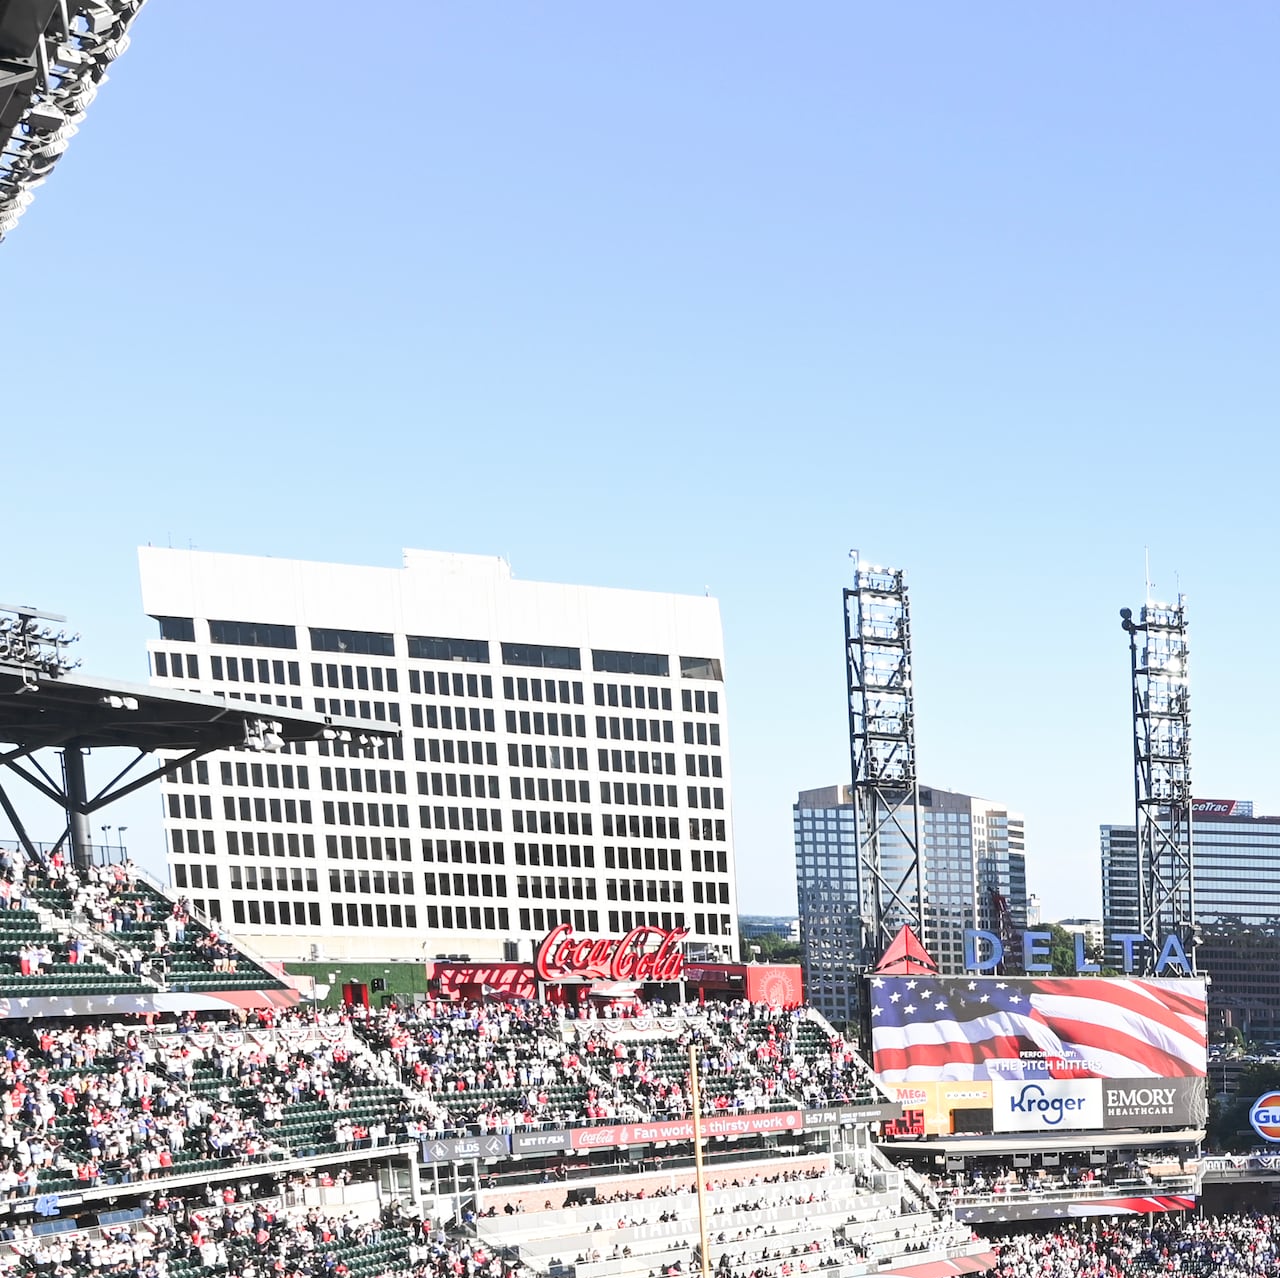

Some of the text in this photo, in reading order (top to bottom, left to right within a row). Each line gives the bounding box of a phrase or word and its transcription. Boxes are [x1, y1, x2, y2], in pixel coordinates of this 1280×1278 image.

[963, 929, 1193, 973] DELTA
[1020, 1060, 1054, 1071] PITCH
[896, 1088, 927, 1100] MEGA
[1106, 1088, 1177, 1107] EMORY
[1010, 1084, 1085, 1125] Kroger
[1107, 1107, 1174, 1116] HEALTHCARE
[805, 1112, 824, 1124] 5:57
[823, 1111, 837, 1123] PM
[633, 1126, 658, 1140] Fan
[659, 1120, 692, 1137] work
[709, 1118, 750, 1135] thirsty
[752, 1115, 783, 1129] work
[454, 1143, 480, 1154] NLDS
[35, 1195, 61, 1217] 42
